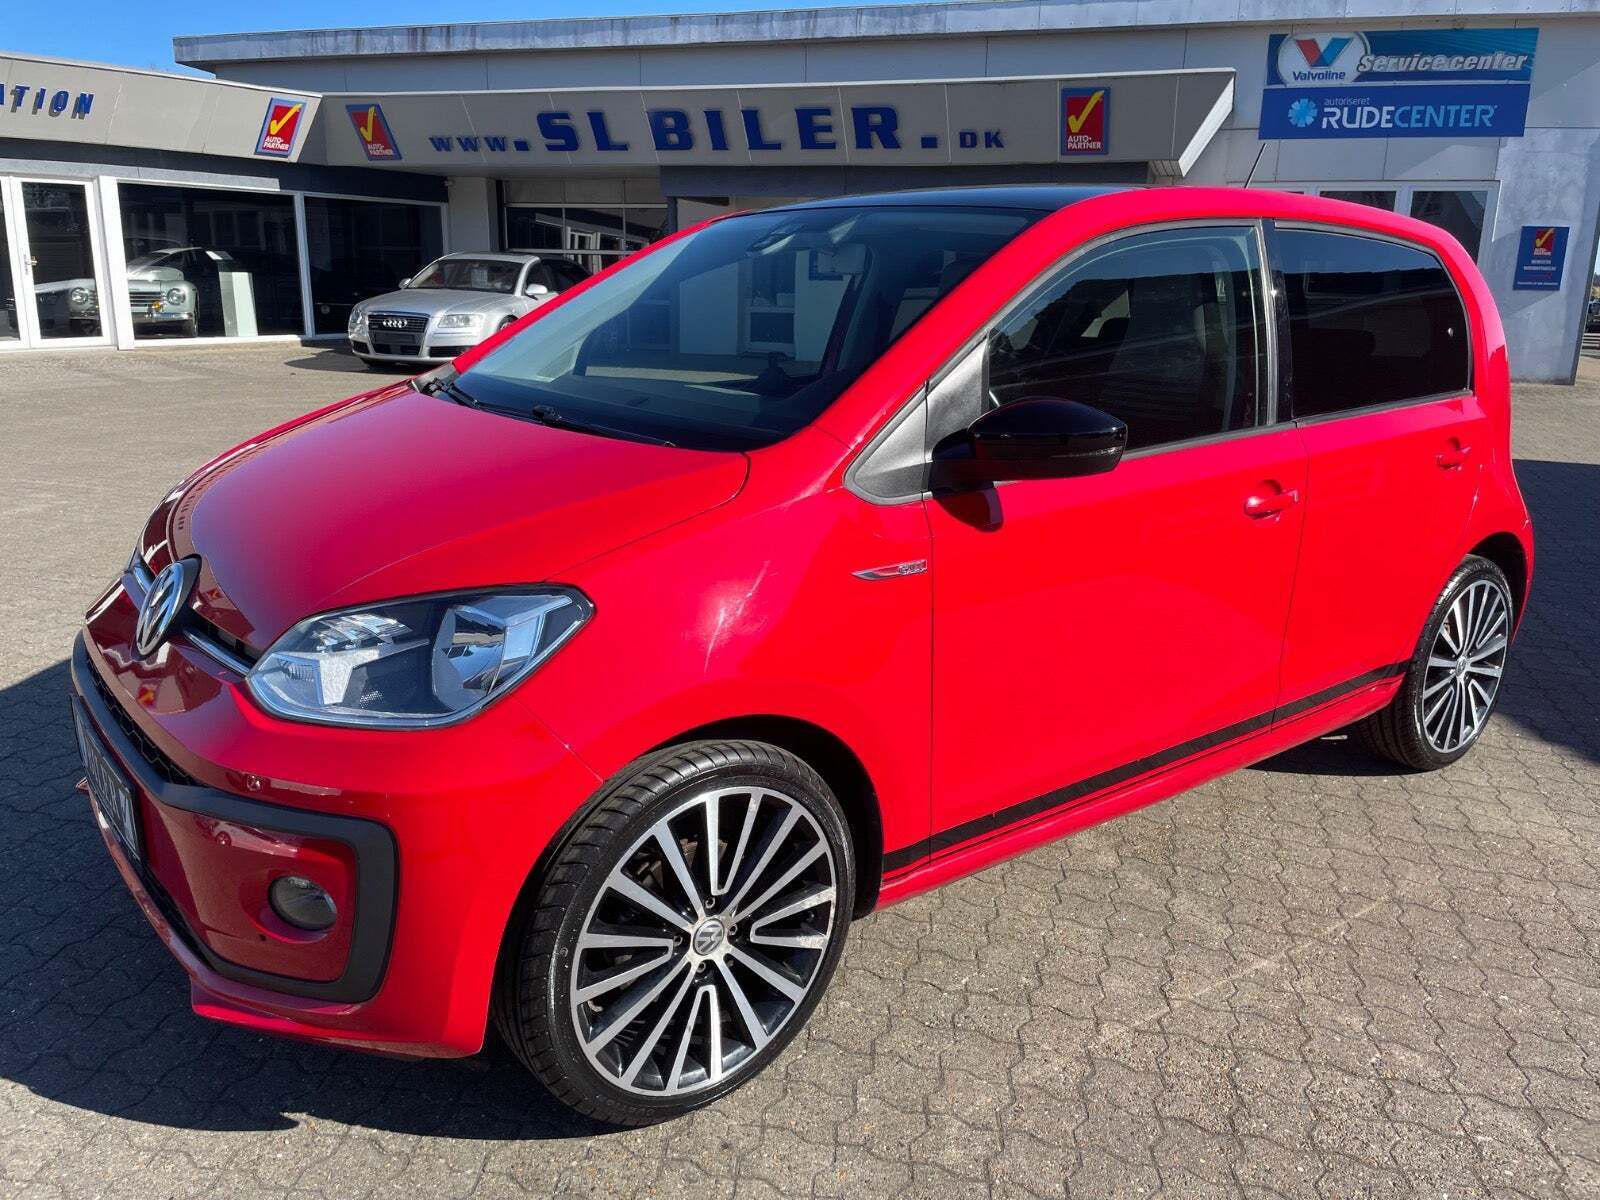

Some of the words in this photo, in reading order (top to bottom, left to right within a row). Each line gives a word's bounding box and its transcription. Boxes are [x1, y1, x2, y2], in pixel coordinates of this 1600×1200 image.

[1292, 71, 1346, 81] Valvoline
[0, 83, 95, 115] TION
[1322, 104, 1496, 129] RUDECENTER
